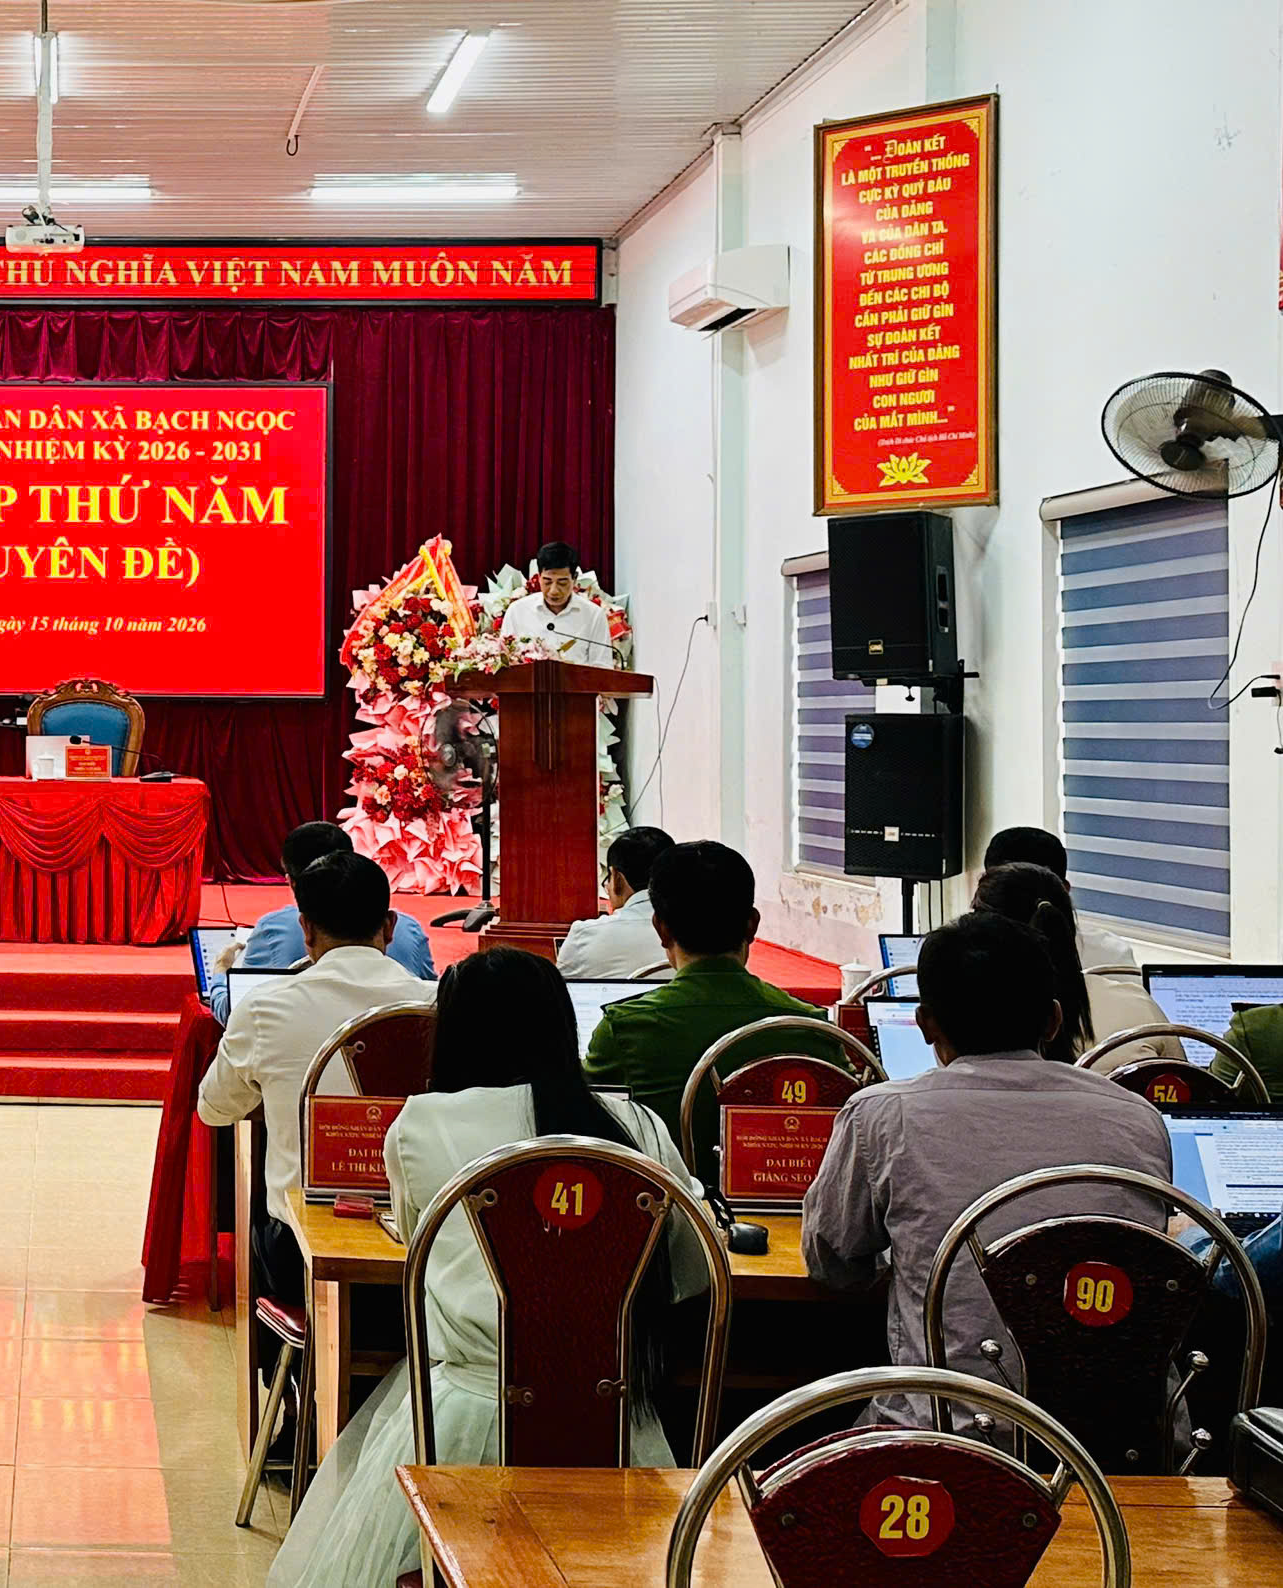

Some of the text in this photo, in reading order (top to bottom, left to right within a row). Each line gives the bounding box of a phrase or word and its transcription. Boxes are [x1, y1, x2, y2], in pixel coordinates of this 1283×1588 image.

[924, 134, 946, 152] KẾT
[841, 151, 970, 186] LÀ MỘT TRUYỀN THỐNG
[859, 175, 952, 205] CỰC KỲ QUÝ BÁU
[876, 200, 934, 221] CỦA ĐẢNG
[904, 220, 929, 238] DÂN
[864, 238, 945, 264] CÁC ĐỒNG CHÍ
[65, 253, 178, 287] NGHĨA
[186, 257, 271, 293] VIỆT
[280, 259, 360, 287] NAM
[371, 251, 478, 287] MUÔN
[491, 253, 573, 287] NĂM
[860, 262, 949, 286] TỪ TRUNG ƯƠNG
[859, 280, 950, 306] ĐẾN CÁC CHI BỘ
[855, 302, 954, 328] CẦN PHẢI GIỮ GÌN
[867, 323, 941, 349] SỰ ĐOÀN KẾT
[849, 342, 960, 369] NHẤT TRÍ CỦA ĐẢNG
[869, 367, 939, 388] NHƯ GIỮ GÌN
[873, 393, 897, 409] CON
[29, 403, 84, 430] DÂN
[92, 405, 128, 431] XÃ
[135, 409, 210, 435] BẠCH
[217, 409, 296, 435] NGỌC
[854, 413, 877, 431] CỦA
[879, 410, 905, 429] MẮT
[93, 435, 131, 460] KỲ
[138, 441, 190, 461] 2026
[211, 441, 262, 461] 2031
[29, 473, 151, 523] THỨ
[161, 474, 289, 524] NĂM
[121, 537, 201, 588] ĐỀ)
[30, 616, 48, 631] 15
[52, 616, 99, 635] tháng
[104, 617, 123, 632] 10
[127, 617, 163, 632] năm
[167, 616, 207, 632] 2026
[782, 1080, 807, 1104] 49
[1153, 1085, 1178, 1103] 54
[551, 1182, 584, 1215] 41
[1076, 1278, 1114, 1312] 90
[879, 1495, 930, 1540] 28
